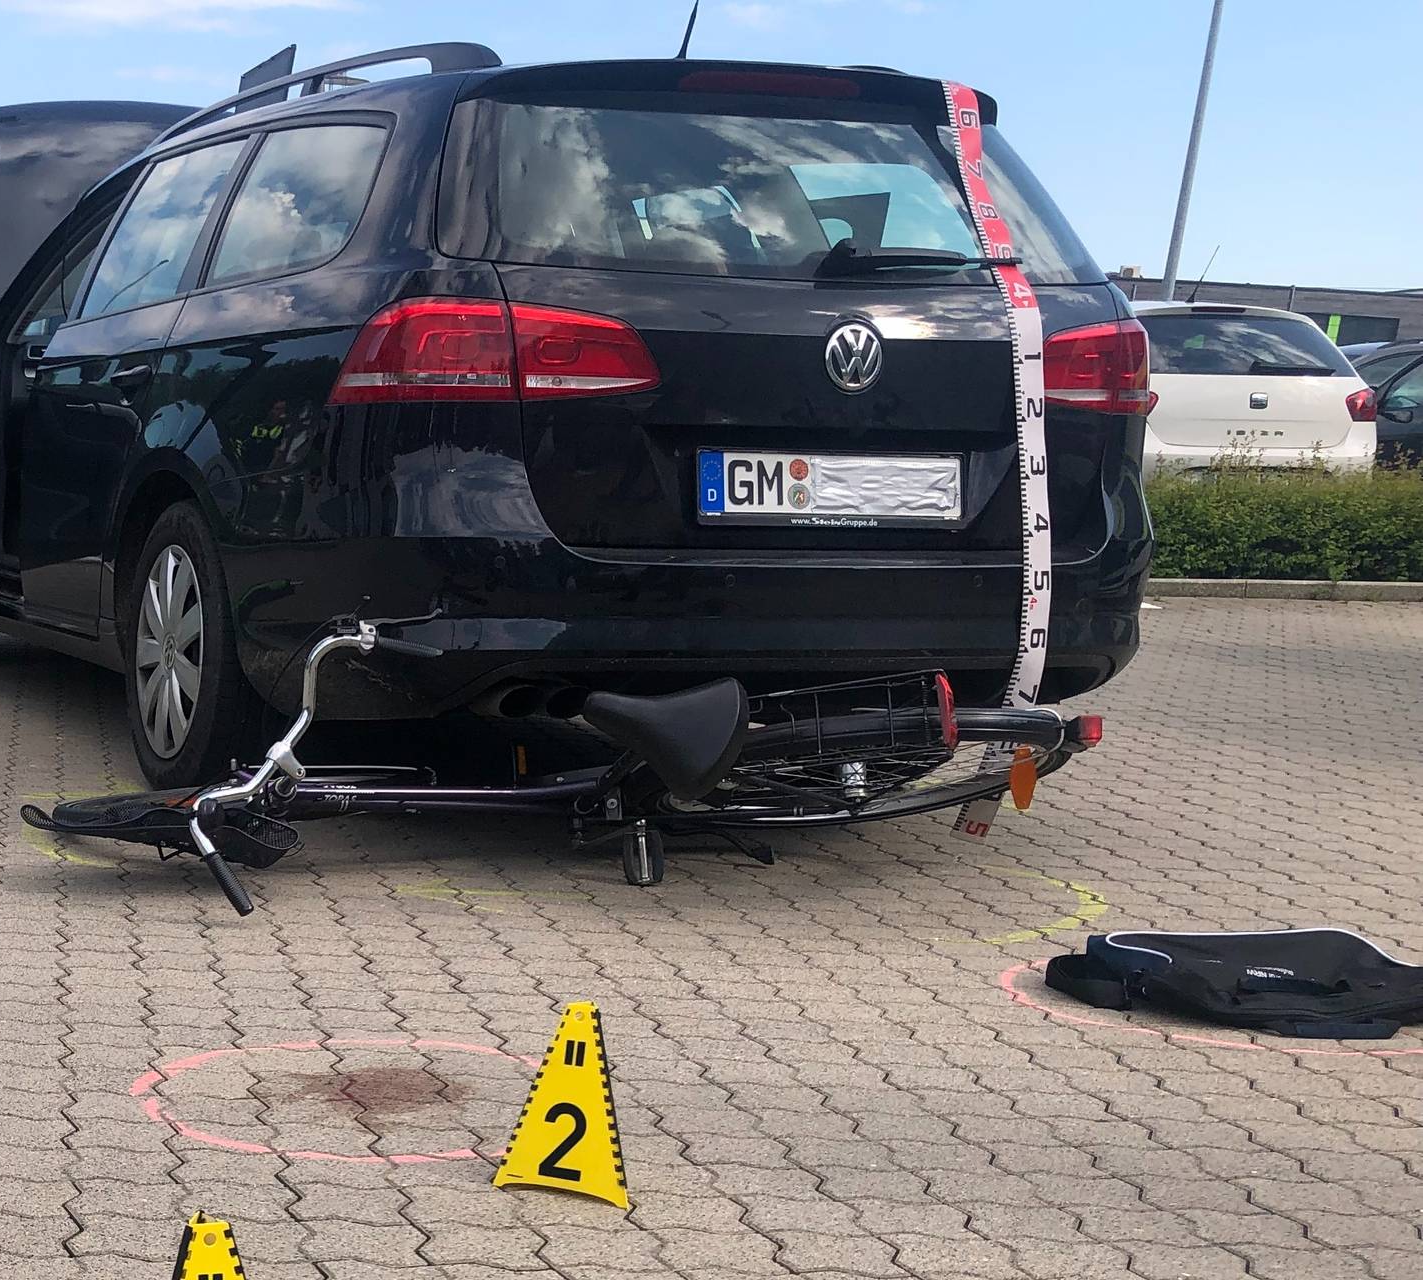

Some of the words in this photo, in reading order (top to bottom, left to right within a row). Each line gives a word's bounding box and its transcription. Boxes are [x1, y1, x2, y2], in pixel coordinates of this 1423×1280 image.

[959, 108, 980, 129] 6
[965, 159, 982, 180] 7
[978, 202, 1000, 220] 8
[1014, 282, 1032, 299] 4
[1024, 352, 1042, 361] 1
[1026, 398, 1043, 418] 2
[1030, 455, 1046, 476] 3
[727, 459, 784, 506] GM
[707, 488, 717, 502] D
[1034, 513, 1049, 533] 4
[1034, 571, 1050, 591] 5
[1030, 628, 1046, 649] 6
[1018, 685, 1038, 704] 7
[965, 821, 988, 838] 5
[538, 1103, 587, 1182] 2
